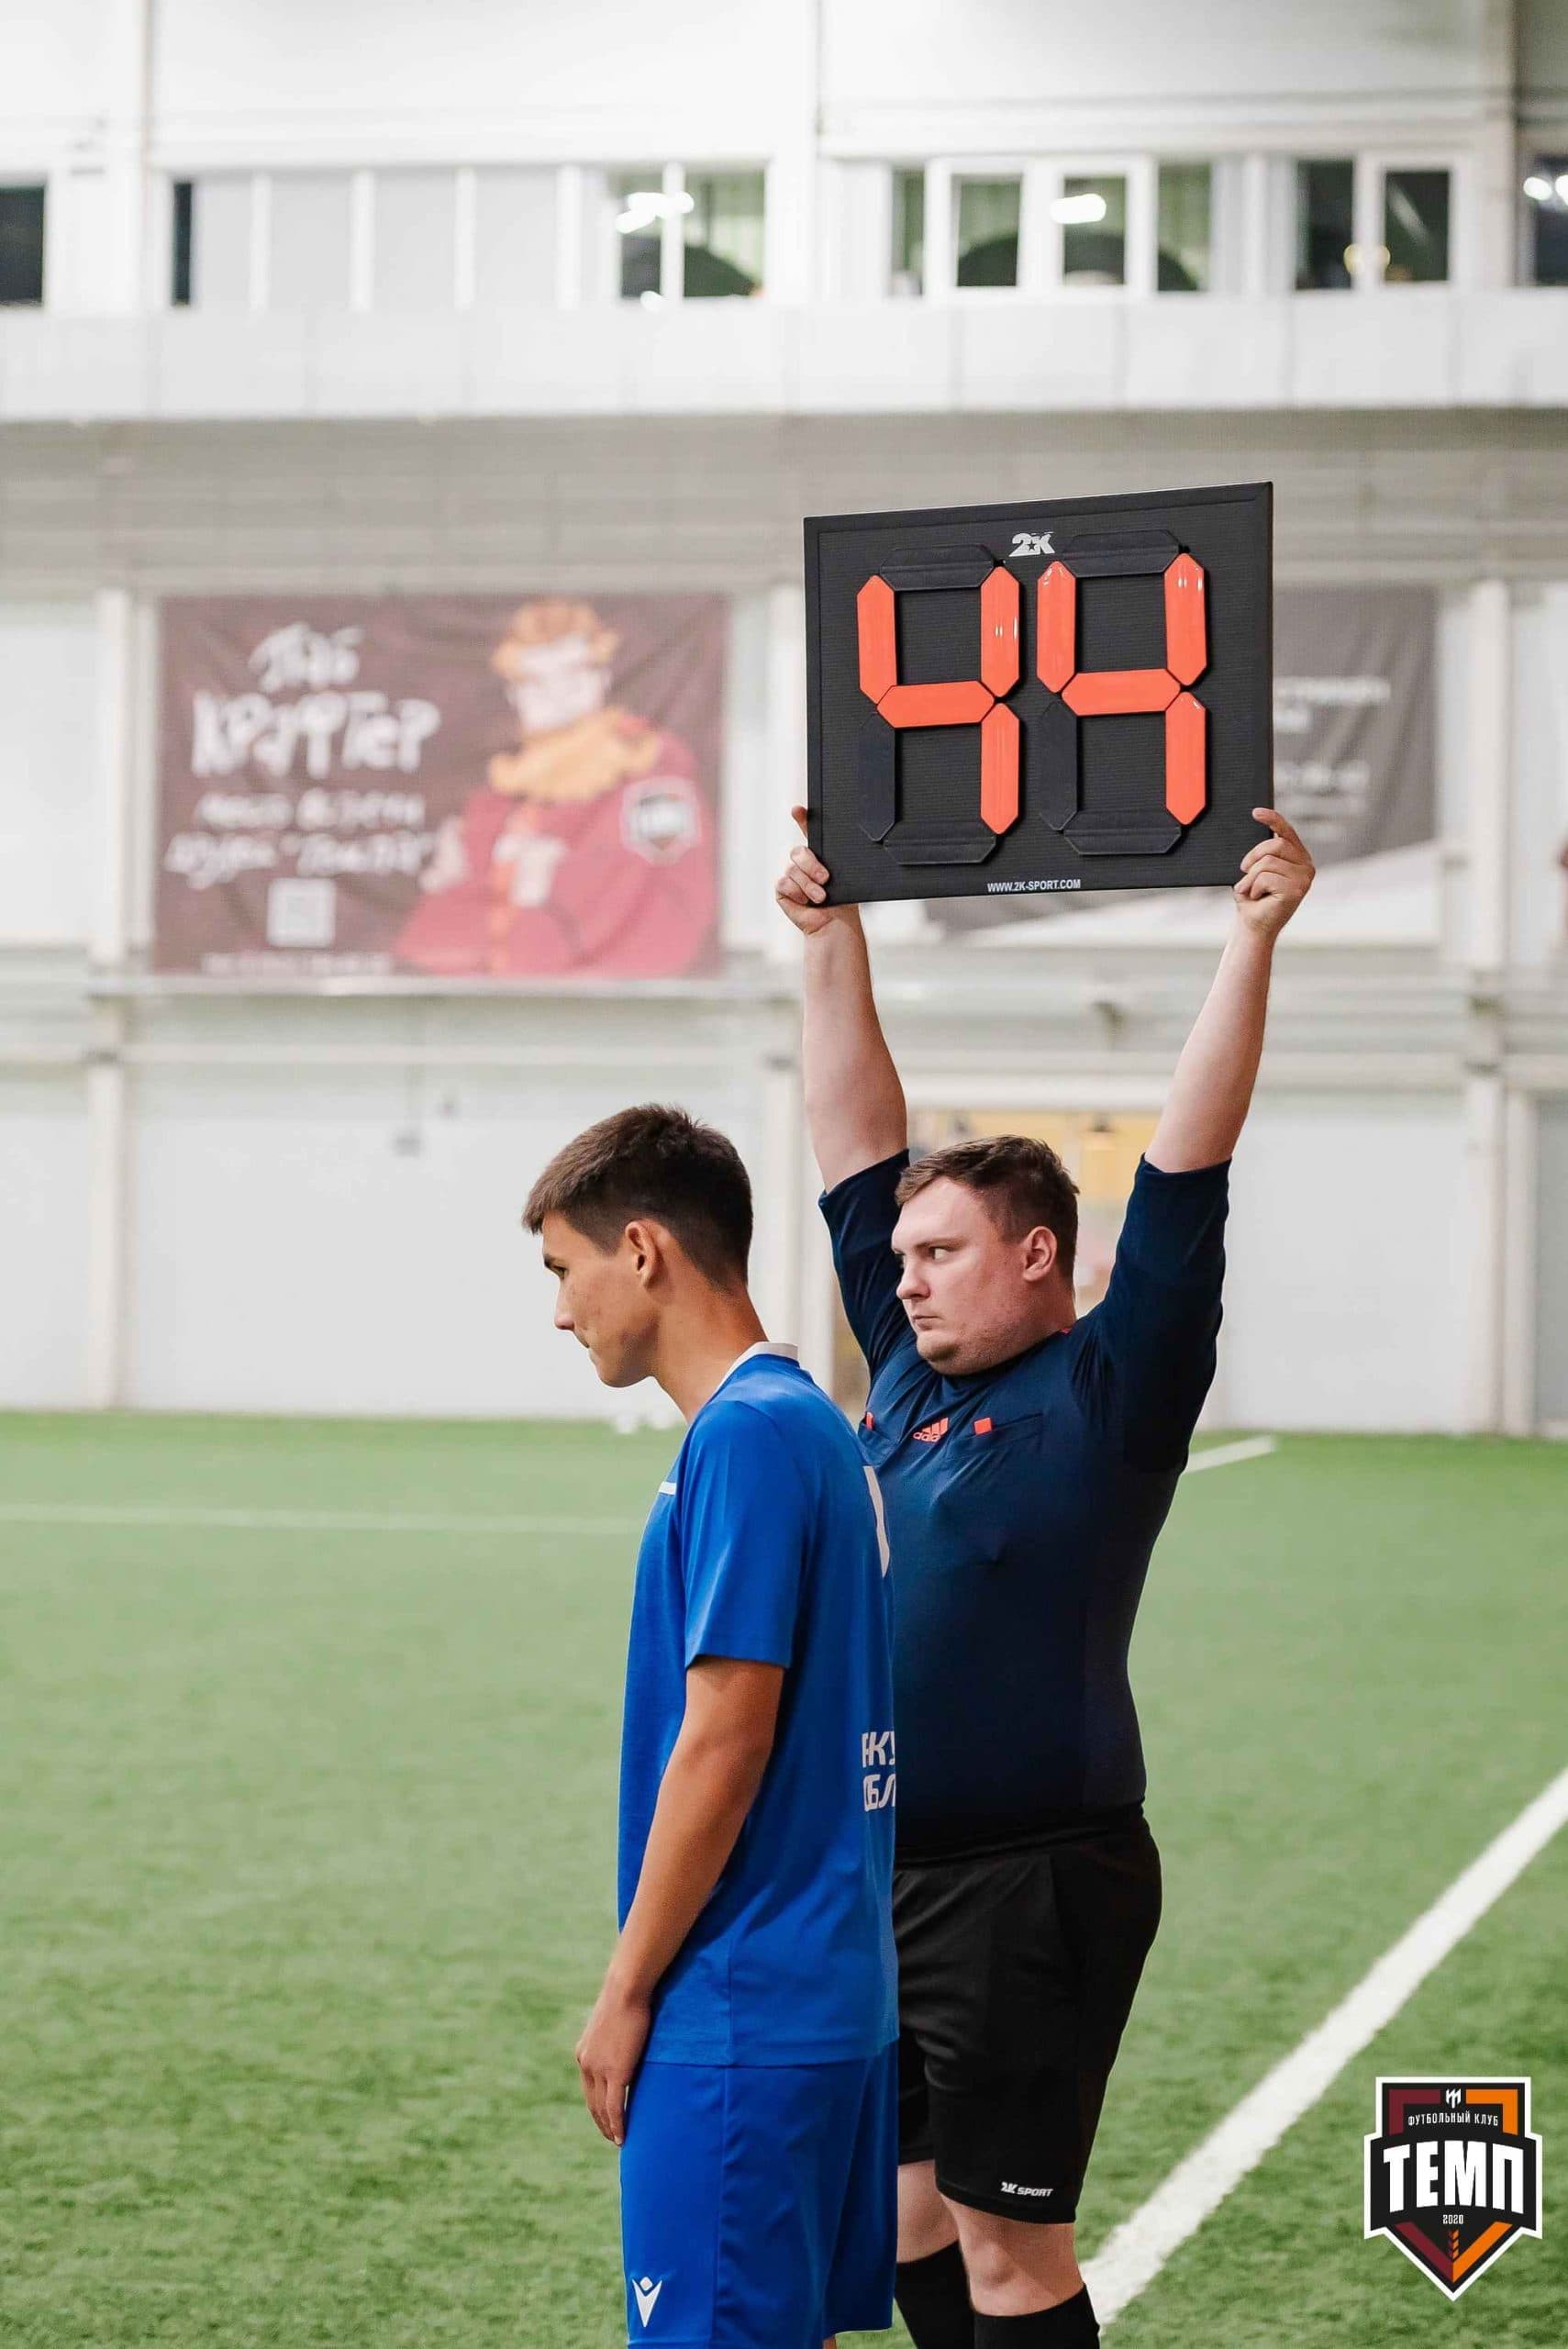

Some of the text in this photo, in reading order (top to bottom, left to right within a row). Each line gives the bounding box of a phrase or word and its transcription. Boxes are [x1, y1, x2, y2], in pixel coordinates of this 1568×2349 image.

[856, 552, 1207, 835] 44
[987, 879, 1082, 893] WWW.2K-SPORT.COM
[1017, 2187, 1054, 2197] SPORT
